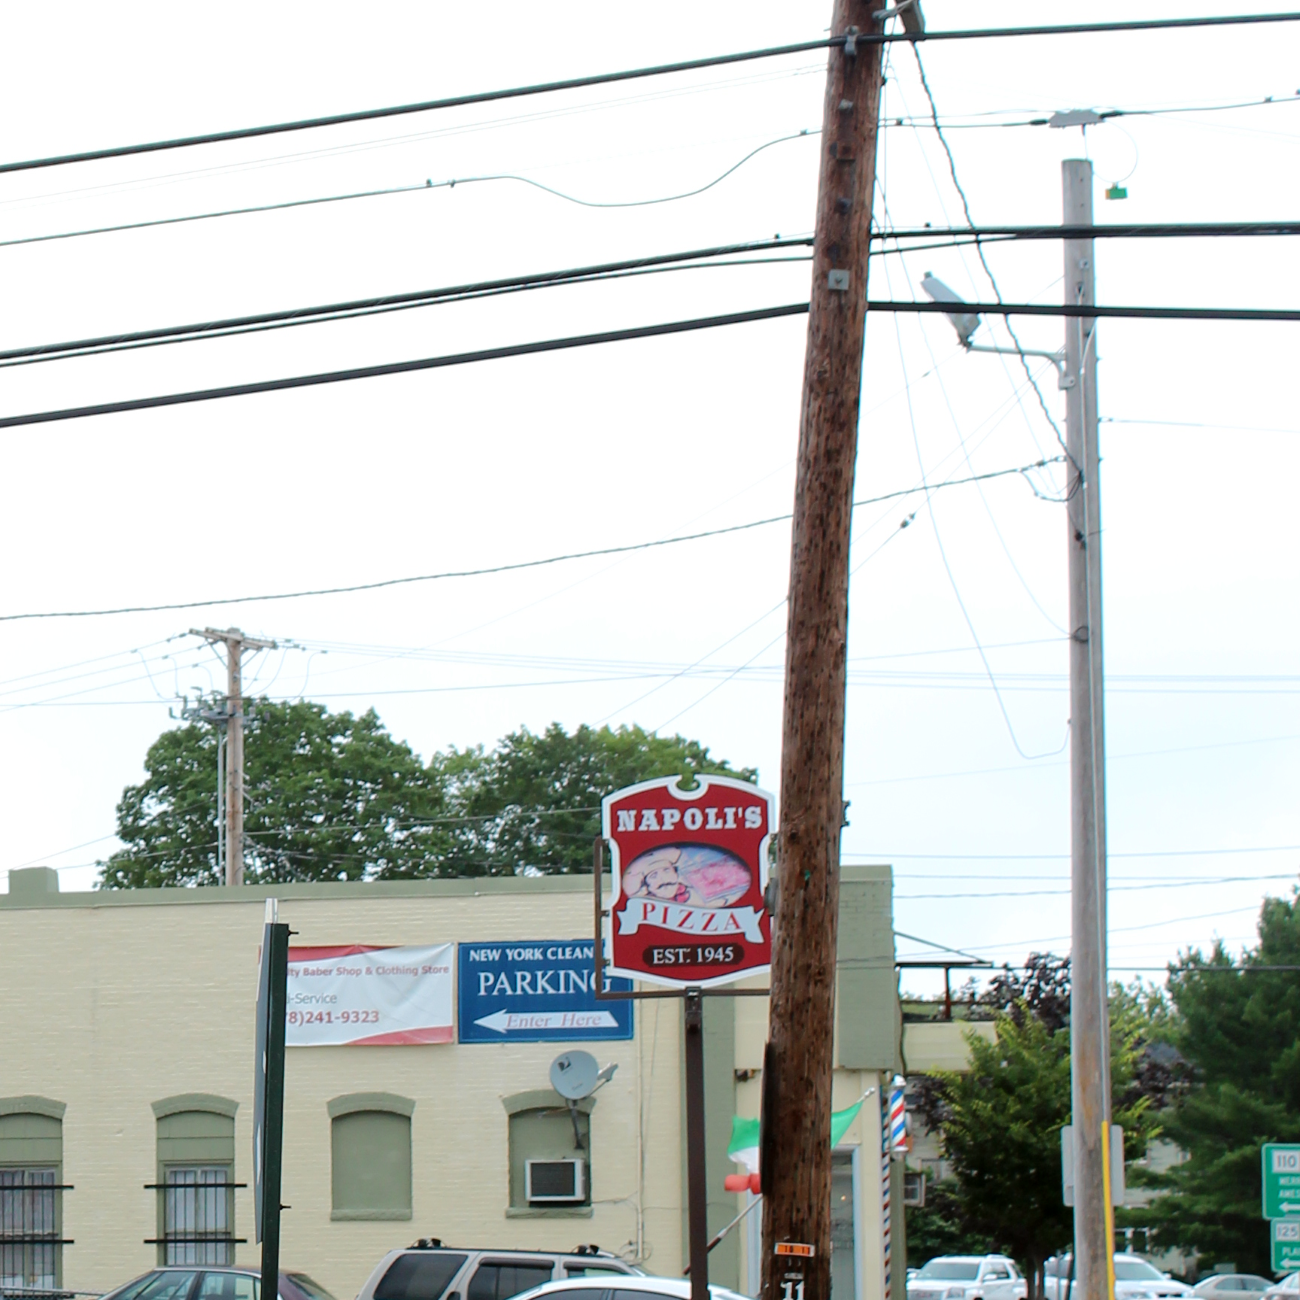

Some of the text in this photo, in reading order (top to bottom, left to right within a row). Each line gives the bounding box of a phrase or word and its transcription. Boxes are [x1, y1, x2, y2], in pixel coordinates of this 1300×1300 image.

[616, 806, 763, 832] NAPOLI'S
[642, 902, 742, 932] PIZZA
[469, 946, 595, 962] NEW YORK CLEAN
[697, 946, 734, 963] 1945
[302, 966, 333, 976] Baber
[336, 966, 362, 978] Shop
[365, 966, 373, 976] &
[375, 965, 419, 977] Clothing
[421, 964, 450, 975] Store
[477, 968, 612, 996] PARKING
[287, 1009, 380, 1027] 8)241-9323
[506, 1012, 602, 1029] Enter Here
[1277, 1155, 1296, 1168] 110
[1277, 1226, 1299, 1237] 125
